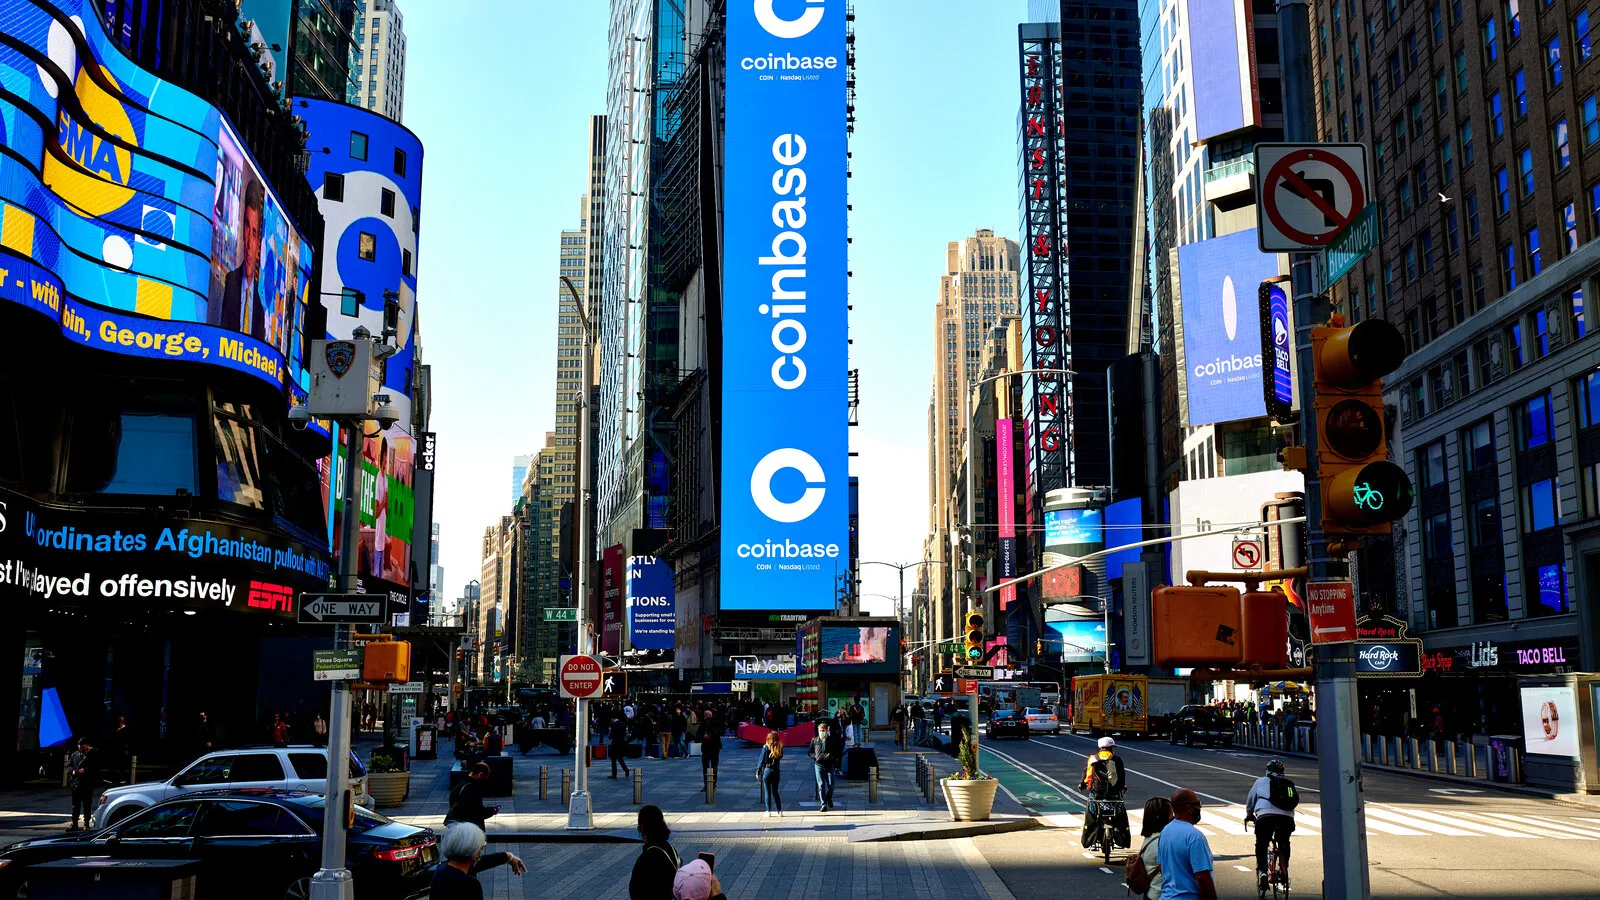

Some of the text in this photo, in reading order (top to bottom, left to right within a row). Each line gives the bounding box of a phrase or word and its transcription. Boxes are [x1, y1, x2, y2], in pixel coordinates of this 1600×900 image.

[741, 53, 837, 70] coinbase
[1328, 214, 1374, 278] Broadway
[758, 133, 807, 390] coinbase
[31, 279, 60, 312] with
[99, 320, 209, 359] George,
[218, 336, 277, 378] Michael
[1275, 347, 1289, 361] TACO
[1195, 354, 1262, 377] coinbas
[1276, 359, 1290, 372] BELL
[1196, 517, 1212, 532] In
[154, 527, 272, 563] Afghanistan
[274, 549, 304, 570] pullout
[737, 539, 839, 558] coinbase
[100, 575, 236, 606] offensively
[248, 580, 294, 612] ESPN
[1310, 589, 1346, 600] NO STOPPING
[313, 603, 375, 614] ONE WAY
[546, 610, 552, 619] W
[556, 610, 568, 619] 44
[1312, 603, 1336, 616] Anytime
[1378, 628, 1396, 636] Rock
[1360, 650, 1398, 660] Hard Rock
[1472, 640, 1498, 667] Lids
[1517, 647, 1566, 664] TACO BELL
